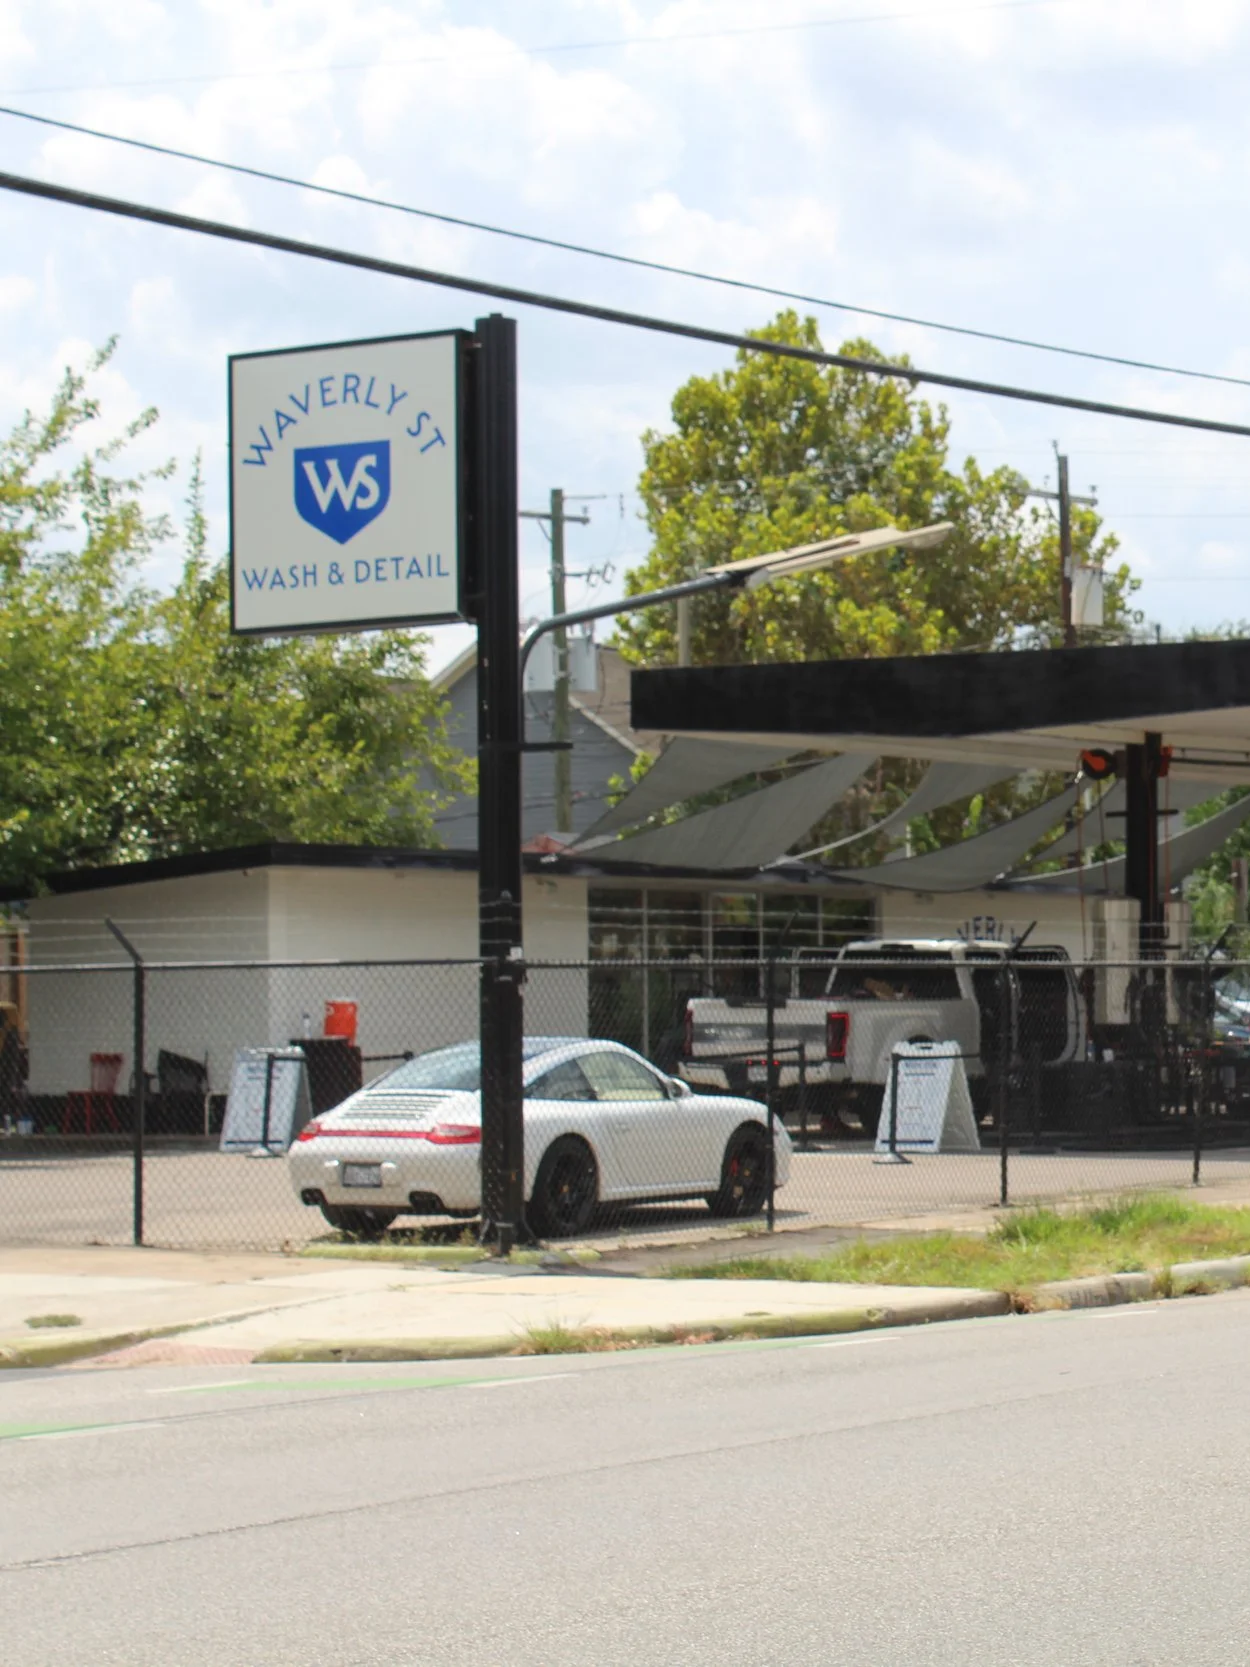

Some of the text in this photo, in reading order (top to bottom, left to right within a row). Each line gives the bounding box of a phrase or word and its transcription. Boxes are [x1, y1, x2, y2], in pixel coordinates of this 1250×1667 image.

[242, 373, 446, 467] WAVERLY ST
[301, 453, 380, 514] WS
[241, 553, 450, 591] WASH & DETAIL
